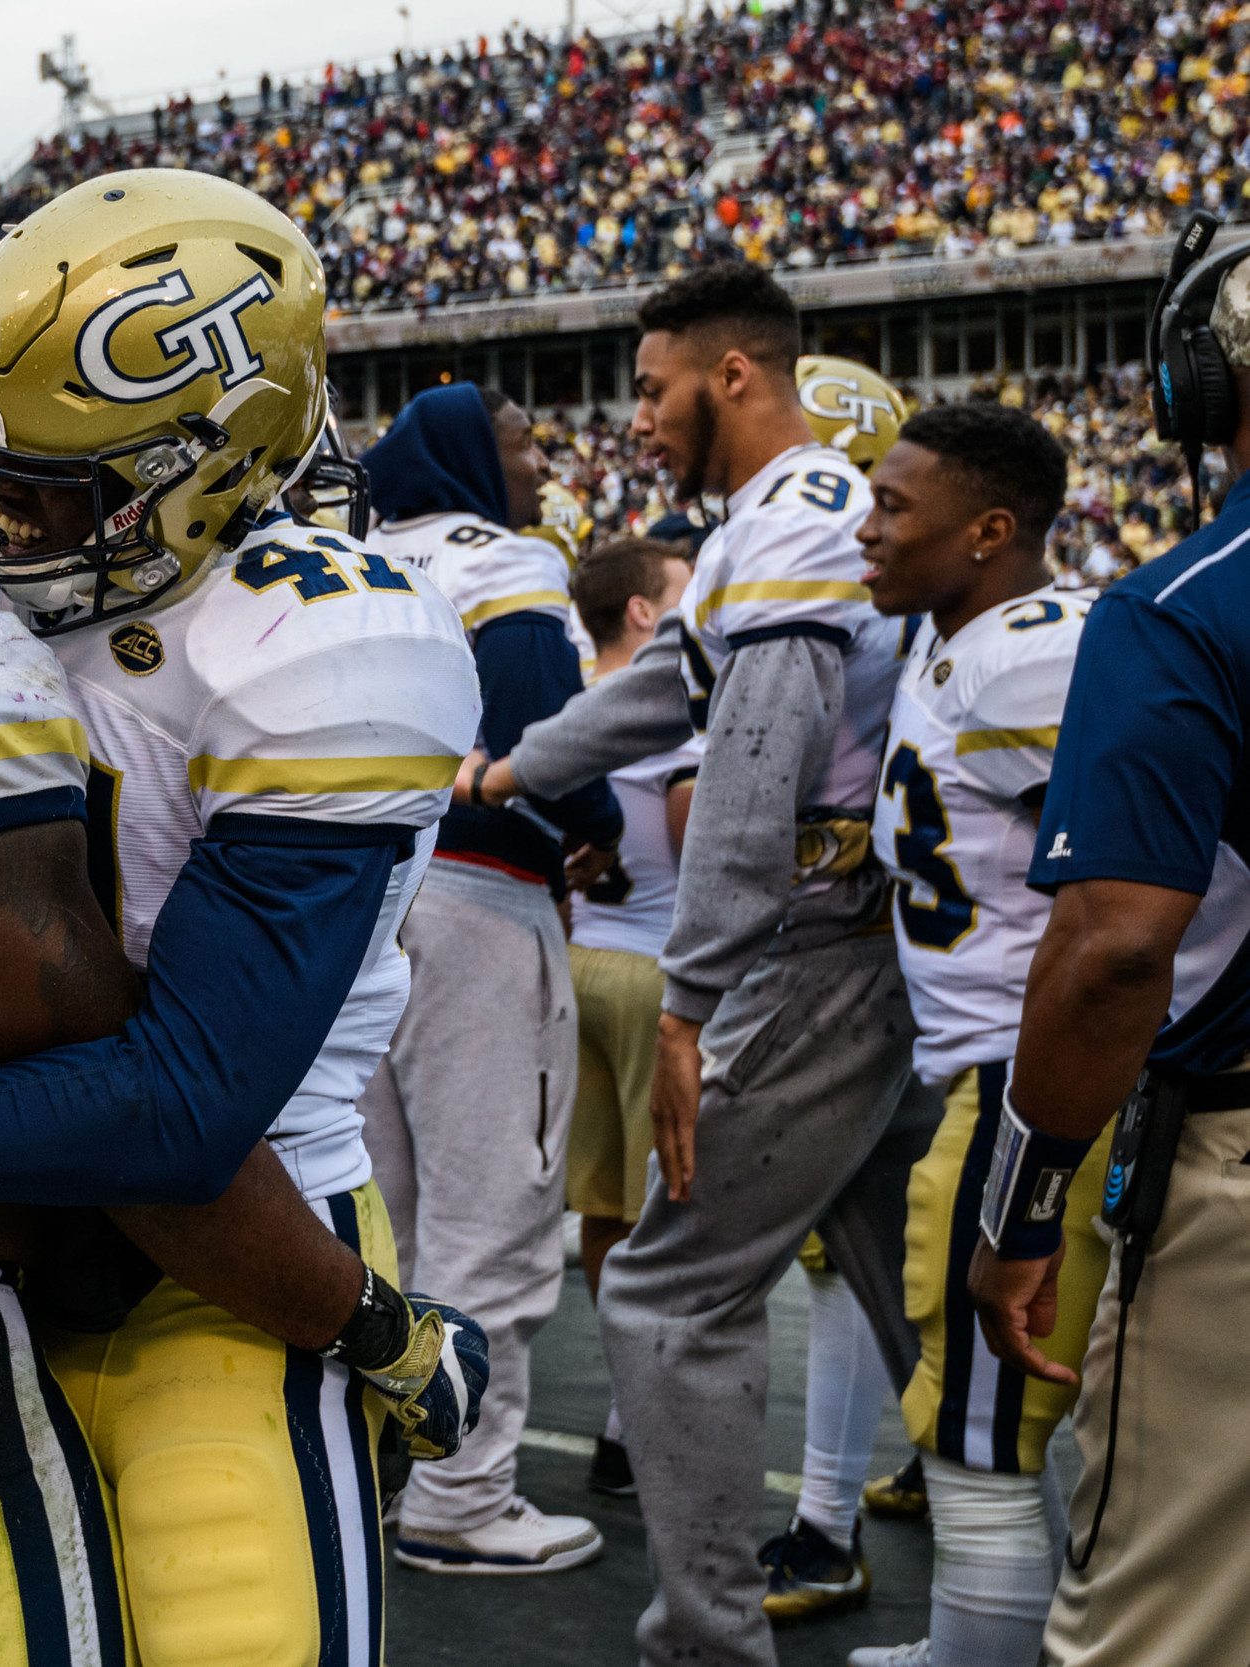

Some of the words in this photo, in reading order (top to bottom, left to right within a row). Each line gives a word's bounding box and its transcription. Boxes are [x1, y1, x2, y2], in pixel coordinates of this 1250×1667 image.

[1183, 221, 1204, 252] AT&T
[74, 268, 276, 404] GT
[799, 376, 893, 435] GT
[231, 535, 419, 607] 41
[117, 632, 159, 661] ACC
[874, 722, 979, 954] 3
